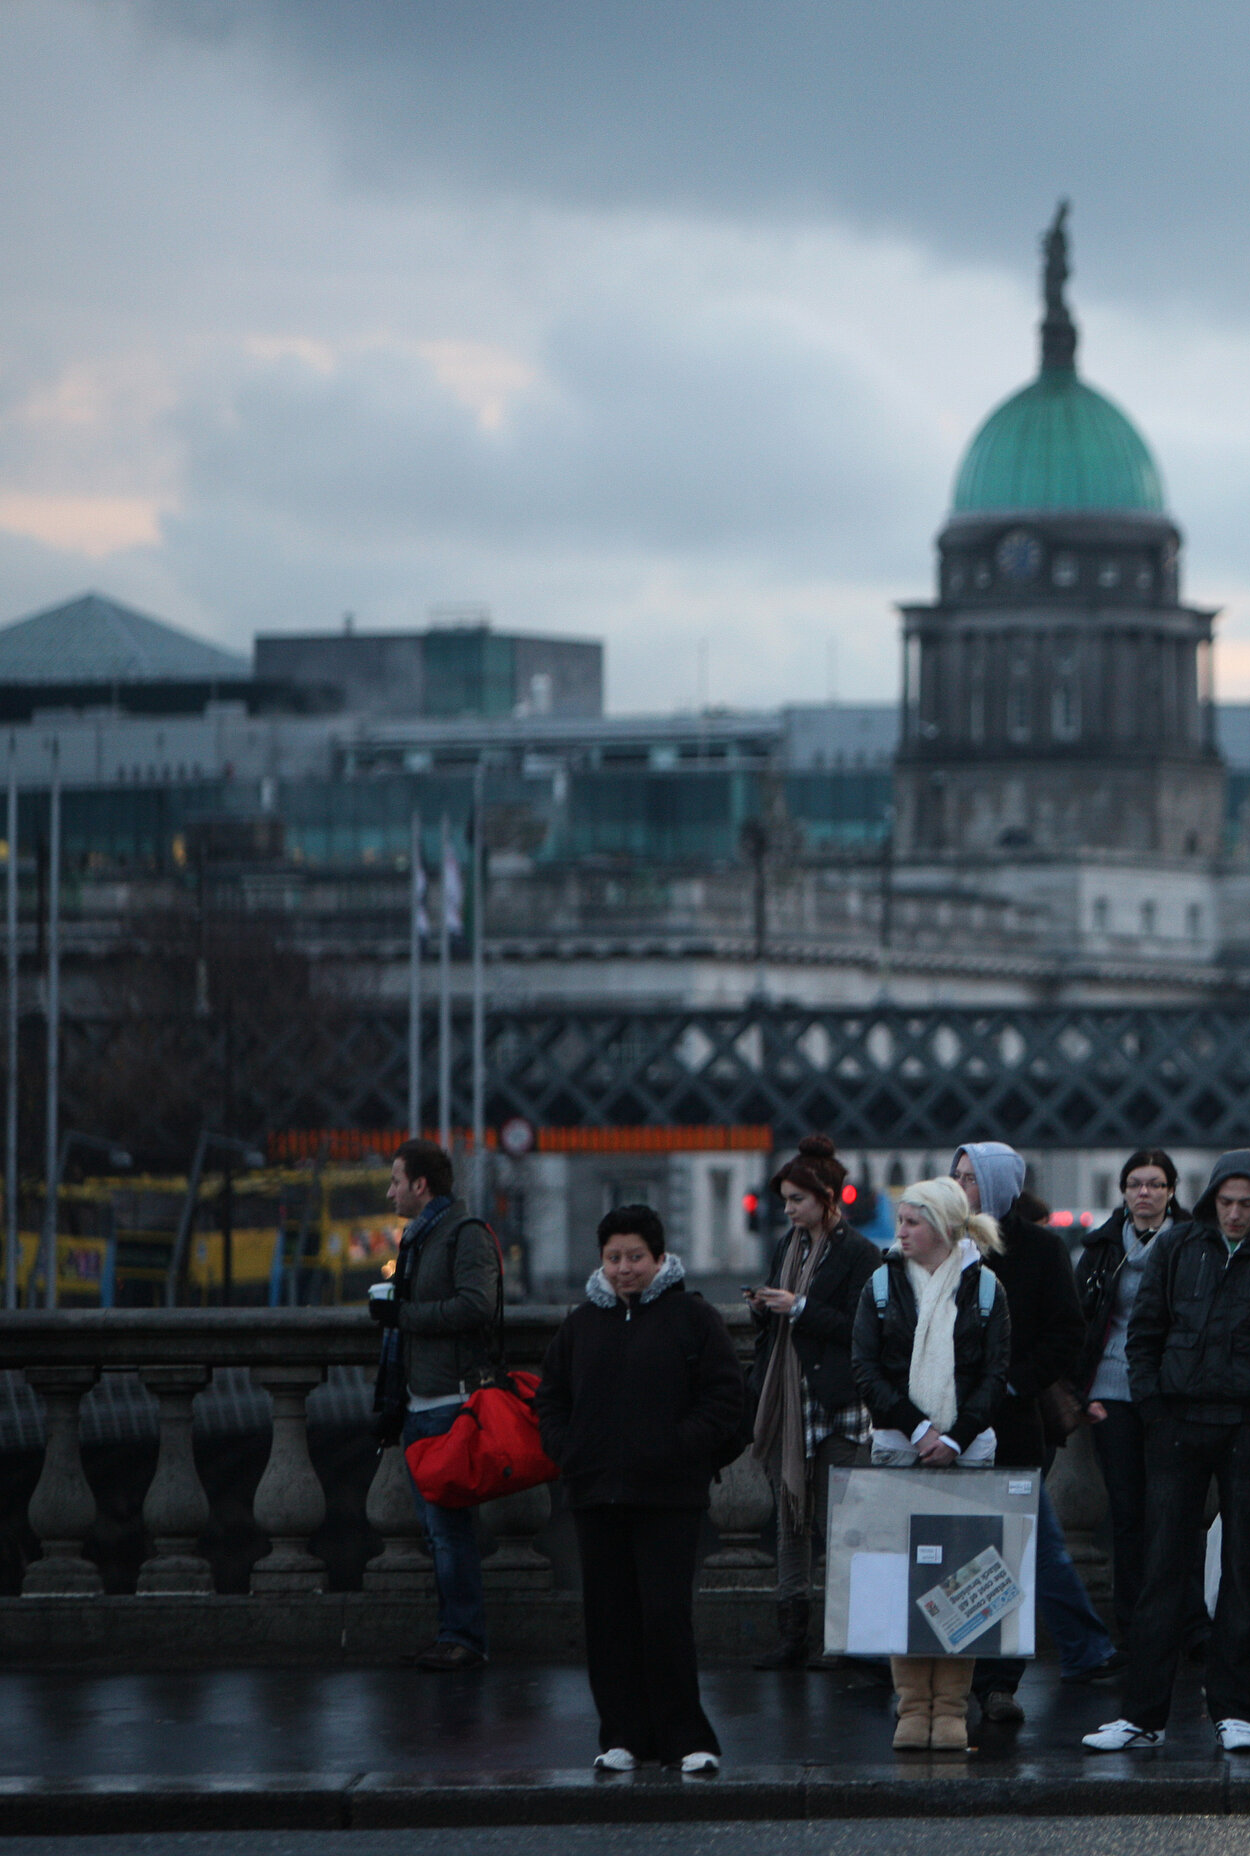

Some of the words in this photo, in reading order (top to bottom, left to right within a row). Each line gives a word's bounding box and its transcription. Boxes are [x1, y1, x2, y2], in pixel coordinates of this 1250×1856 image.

[980, 1560, 1002, 1581] Black
[993, 1568, 1007, 1581] the
[949, 1577, 981, 1605] bruising
[977, 1579, 994, 1596] cost
[986, 1577, 1013, 1602] Ireland
[958, 1599, 970, 1612] All
[969, 1591, 978, 1604] of
[964, 1598, 986, 1619] count
